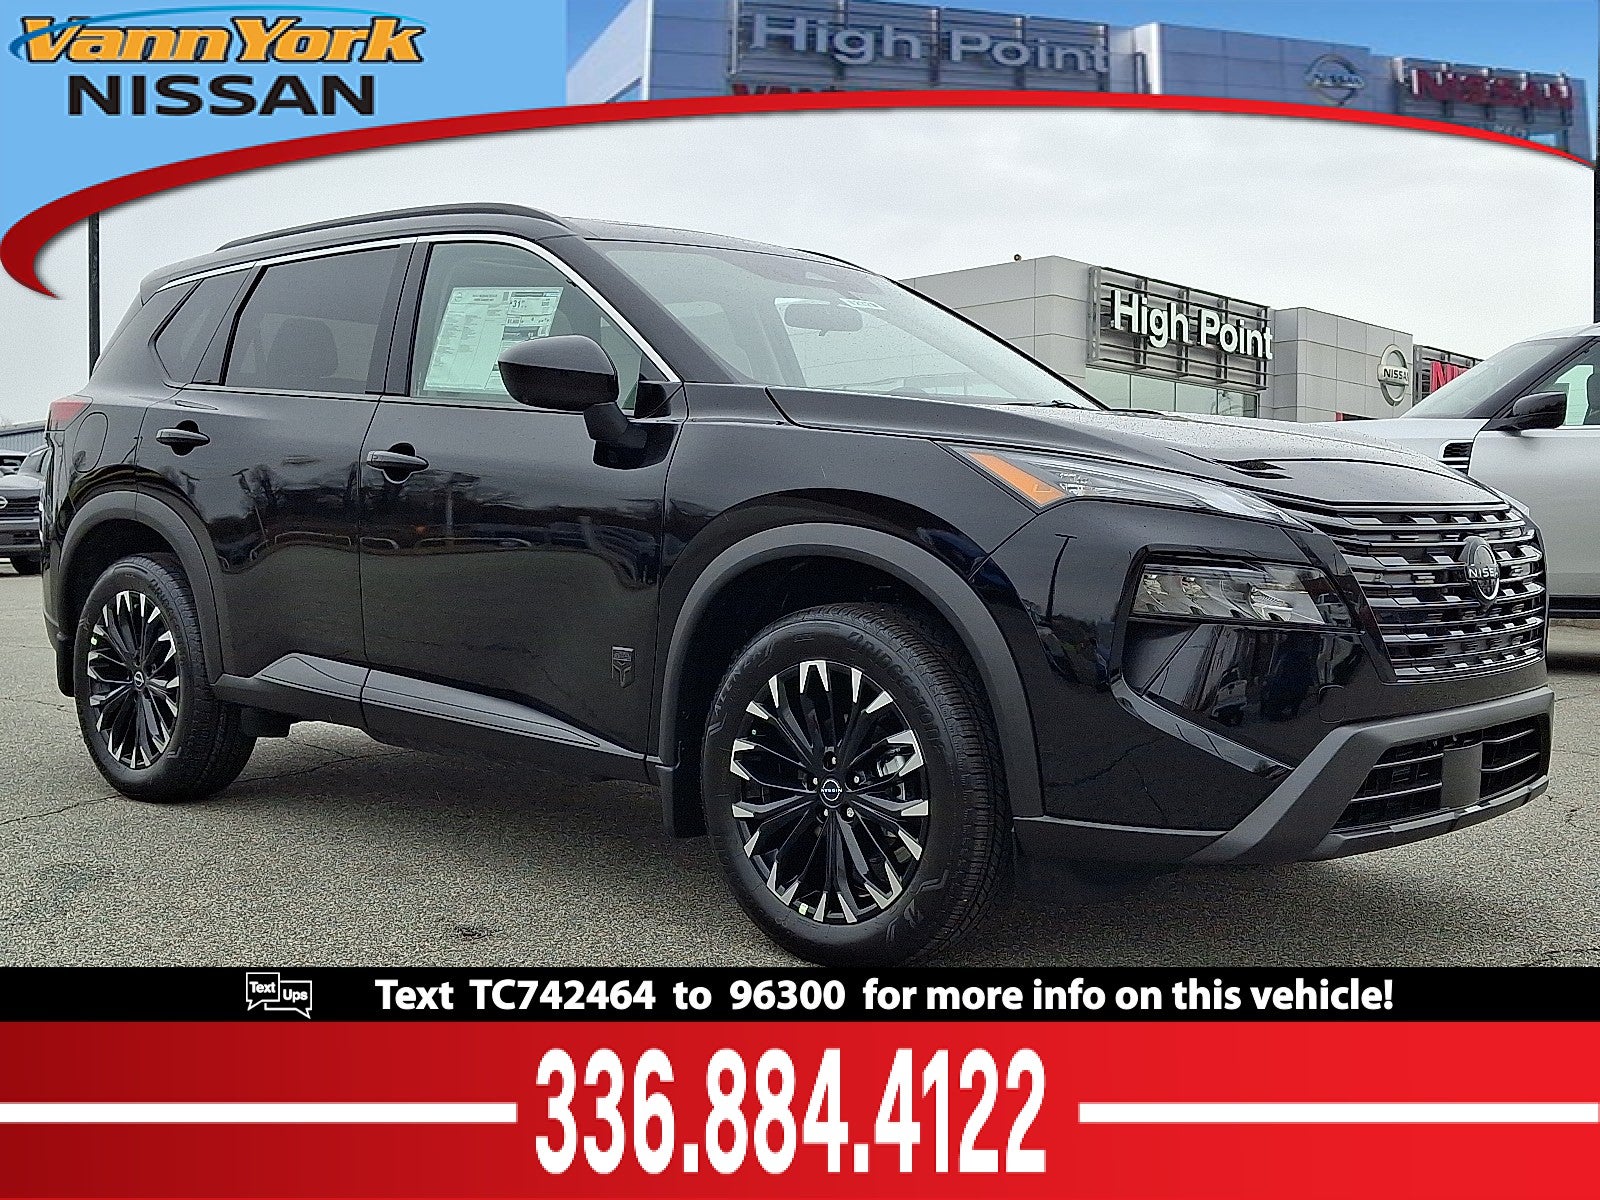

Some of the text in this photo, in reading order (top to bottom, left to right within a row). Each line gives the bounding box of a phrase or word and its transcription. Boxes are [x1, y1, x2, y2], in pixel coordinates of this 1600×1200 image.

[1111, 289, 1274, 360] High Point
[1468, 566, 1499, 579] NISSA
